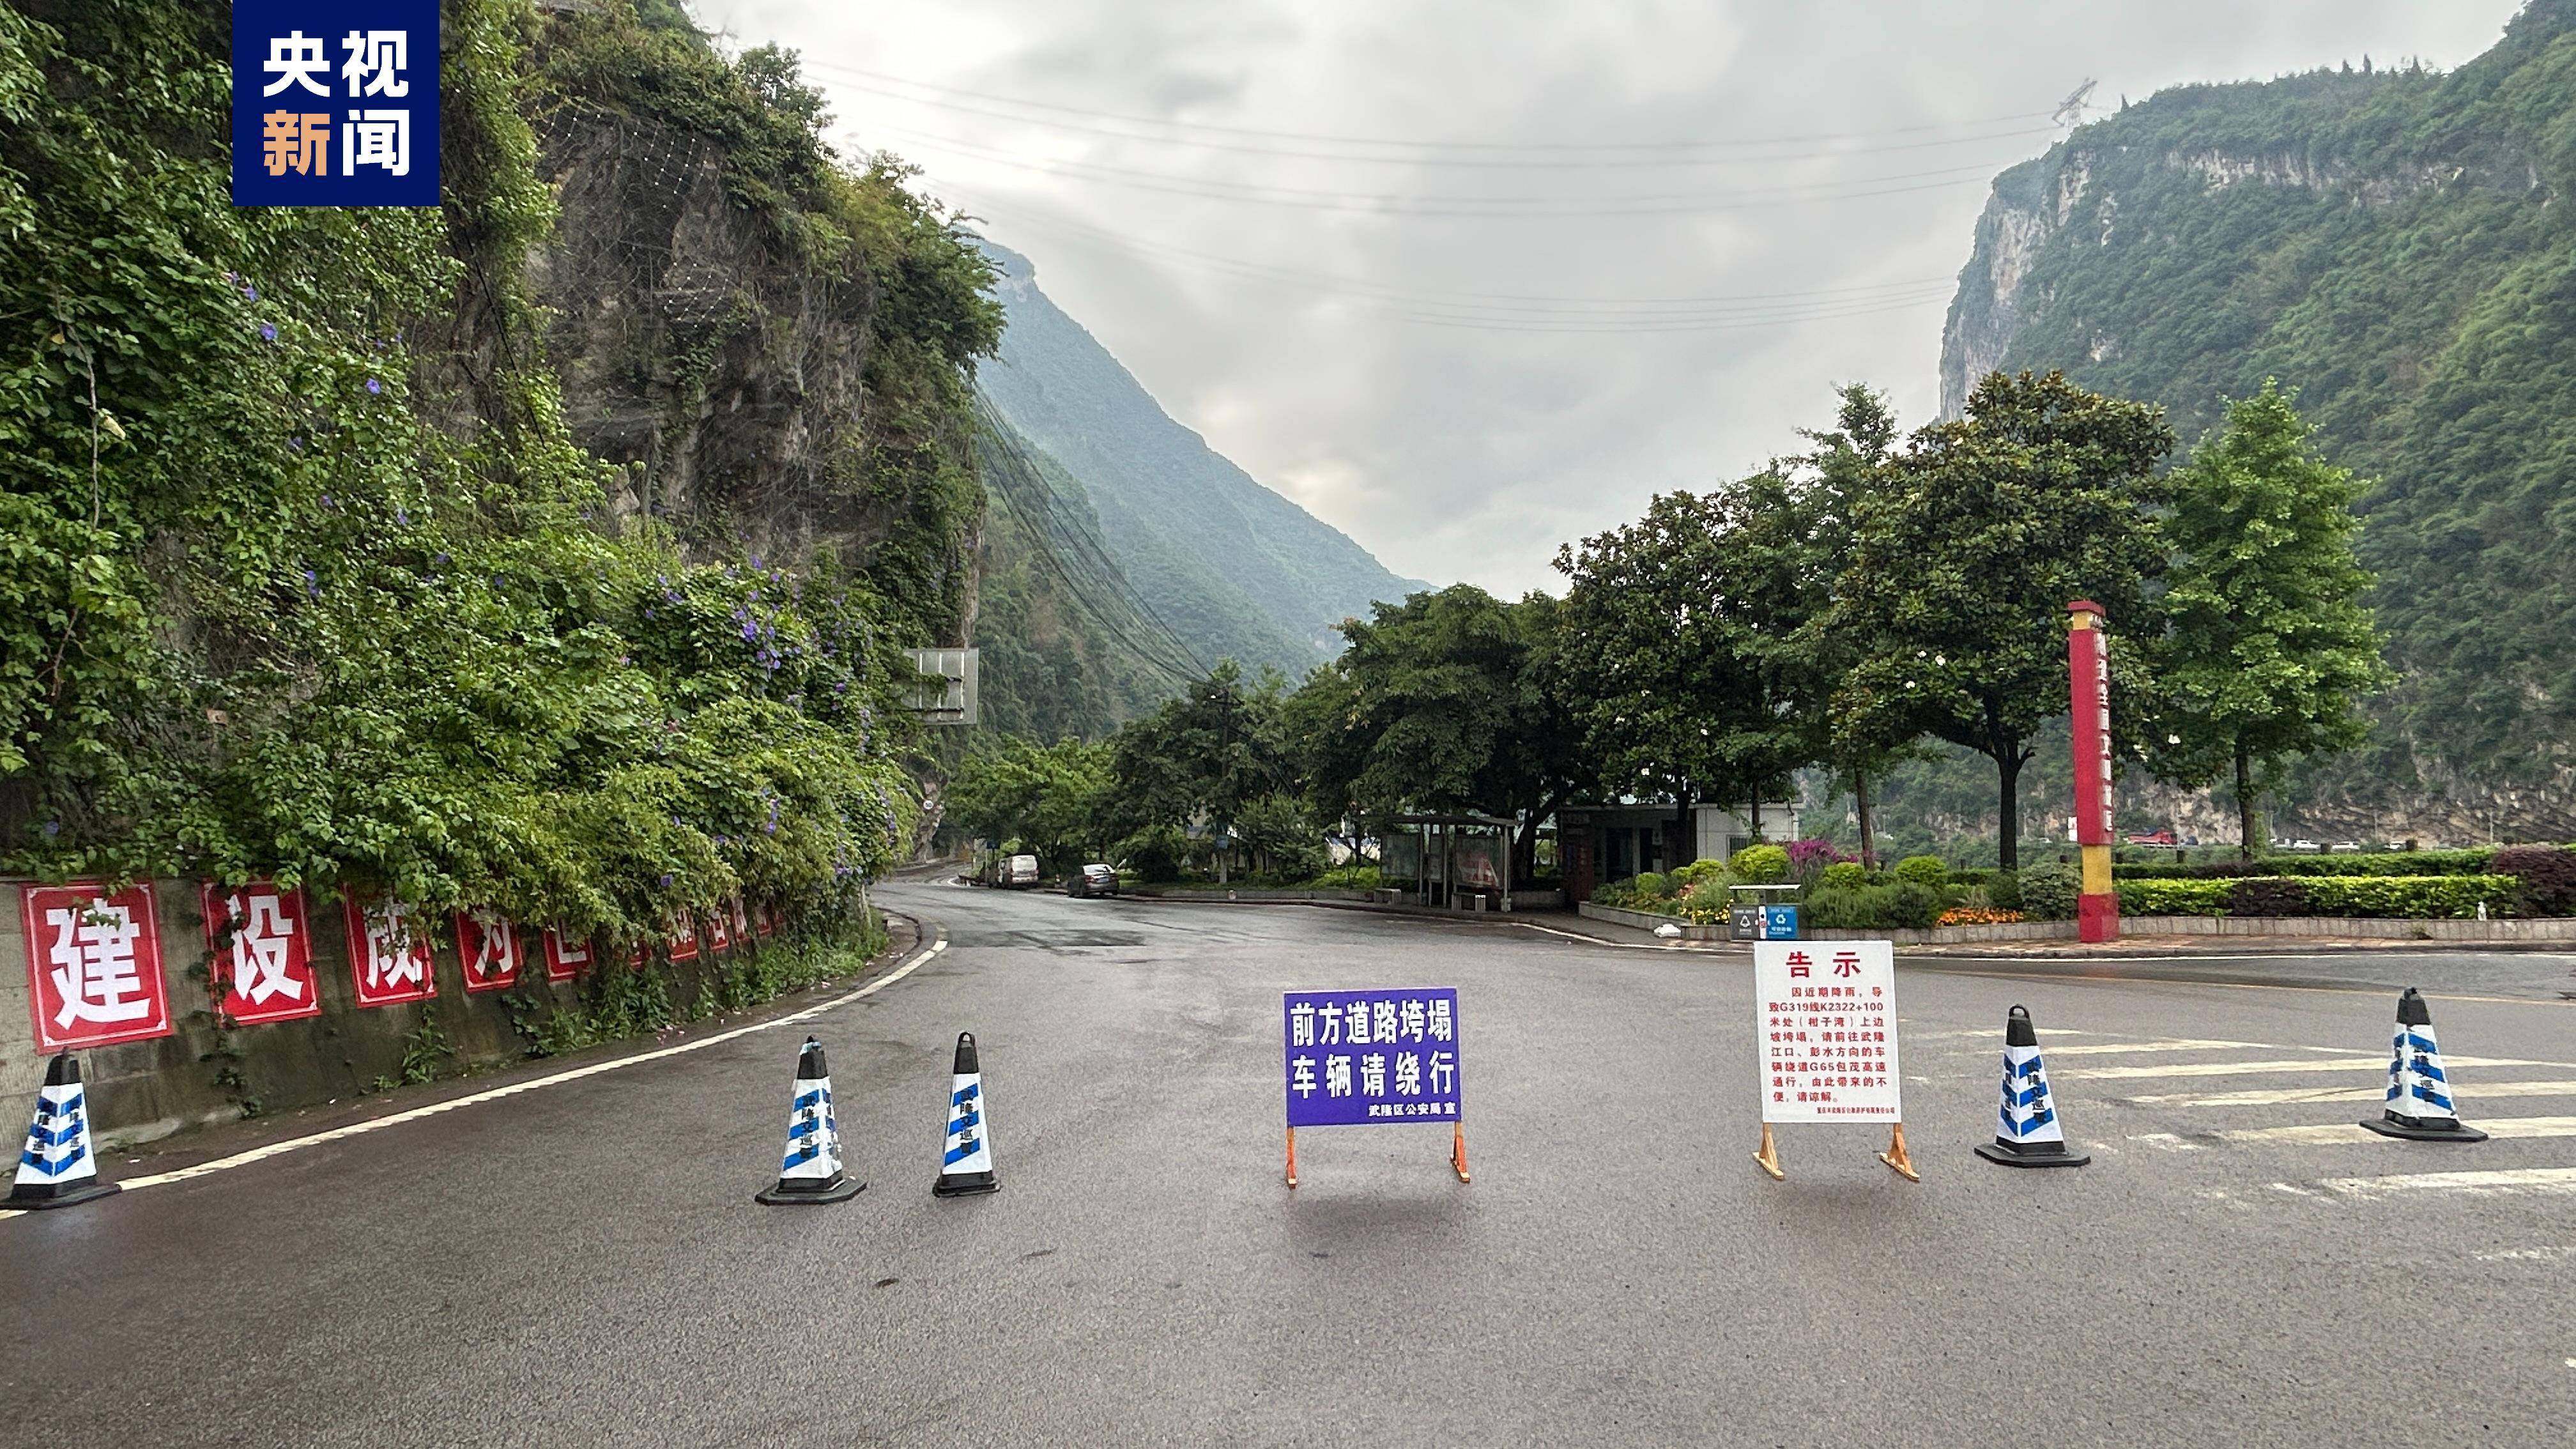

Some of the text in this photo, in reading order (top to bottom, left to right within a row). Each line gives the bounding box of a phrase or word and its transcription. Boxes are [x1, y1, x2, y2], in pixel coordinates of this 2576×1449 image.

[1786, 951, 1861, 977] 告示
[1768, 1002, 1883, 1012] 致G319线K2322+100
[1289, 999, 1453, 1046] 前方道路垮塌
[1771, 1046, 1885, 1057] 江口、彭水方向的车
[1292, 1050, 1454, 1099] 车辆请绕行
